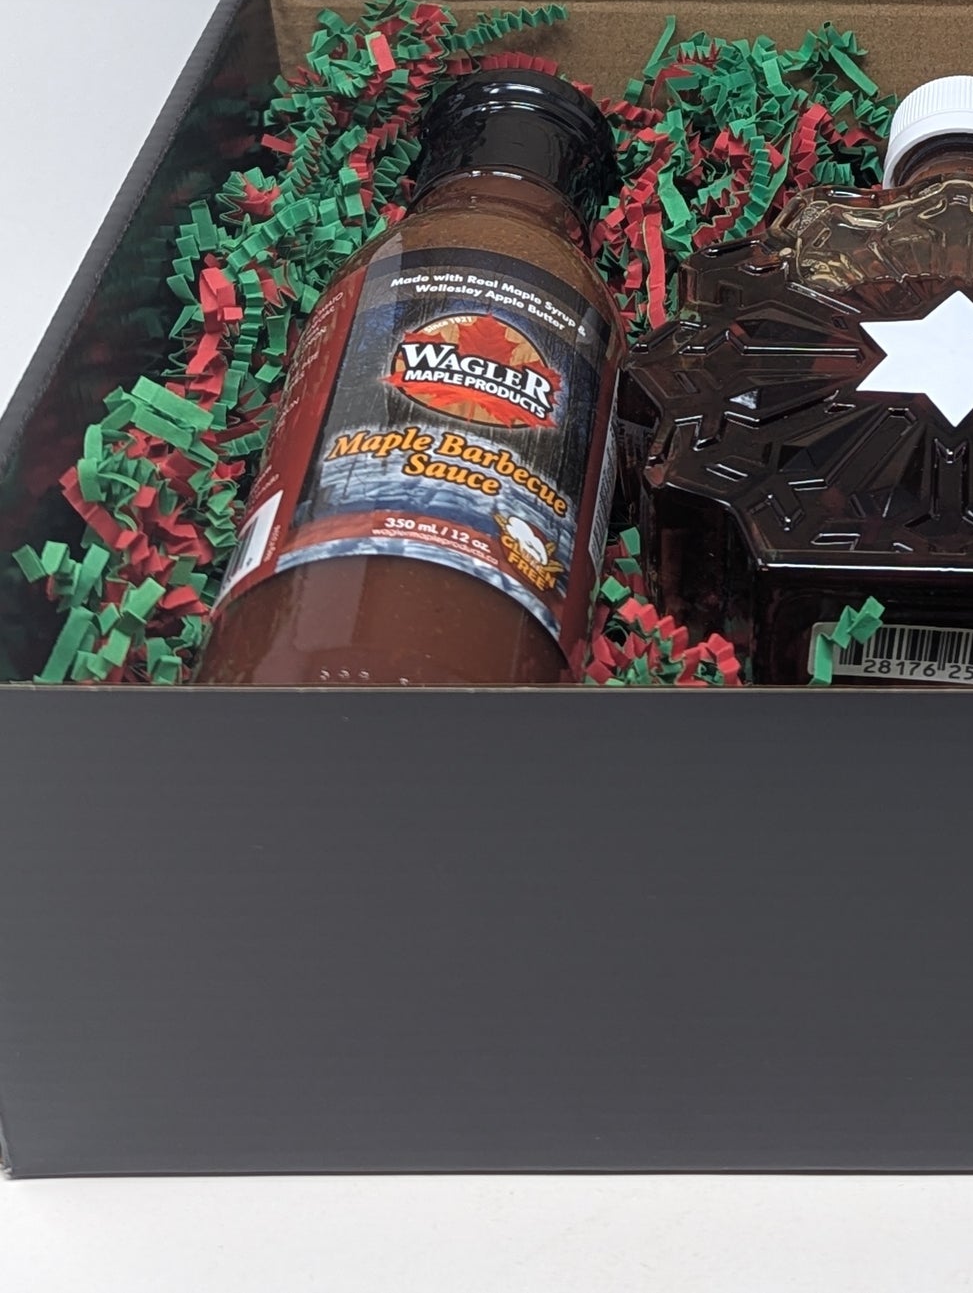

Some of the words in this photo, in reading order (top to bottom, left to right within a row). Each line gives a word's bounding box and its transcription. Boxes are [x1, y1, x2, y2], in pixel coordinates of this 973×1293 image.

[390, 273, 430, 288] Made
[433, 273, 464, 283] with
[466, 275, 499, 289] Real
[501, 282, 542, 306] Maple
[544, 300, 577, 328] Syrup
[577, 322, 588, 337] &
[415, 283, 484, 298] Wellesley
[485, 290, 525, 309] Apple
[527, 304, 567, 332] Butter
[401, 343, 552, 408] WAGLER
[404, 369, 464, 385] MAPLE
[464, 378, 546, 419] PRODUCTS
[325, 426, 434, 460] Maple
[436, 432, 569, 516] Barbecue
[402, 453, 502, 495] Sauce
[384, 517, 416, 531] 350
[418, 522, 439, 536] mL
[450, 530, 471, 545] 12
[508, 553, 545, 592] FREE
[862, 658, 937, 679] 28176
